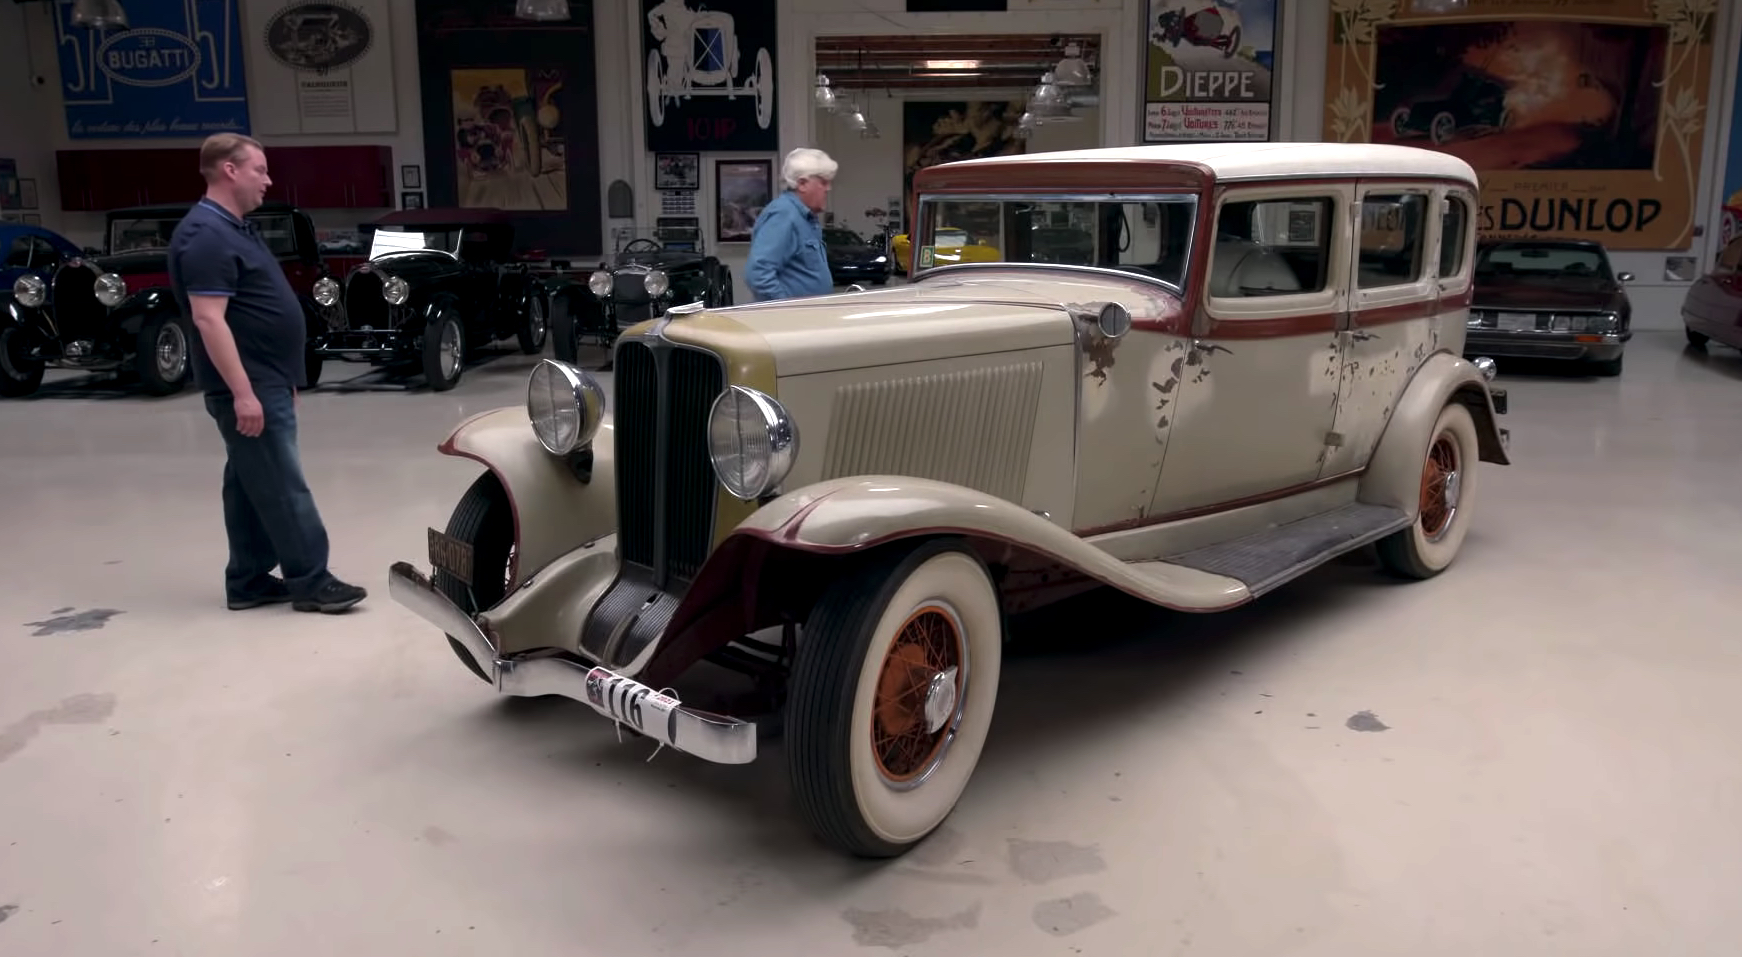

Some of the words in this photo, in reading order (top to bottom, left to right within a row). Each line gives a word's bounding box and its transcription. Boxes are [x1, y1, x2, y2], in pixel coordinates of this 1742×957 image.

[108, 49, 189, 69] BUGATTI
[1500, 198, 1662, 231] DUNLOP
[608, 678, 650, 732] 116
